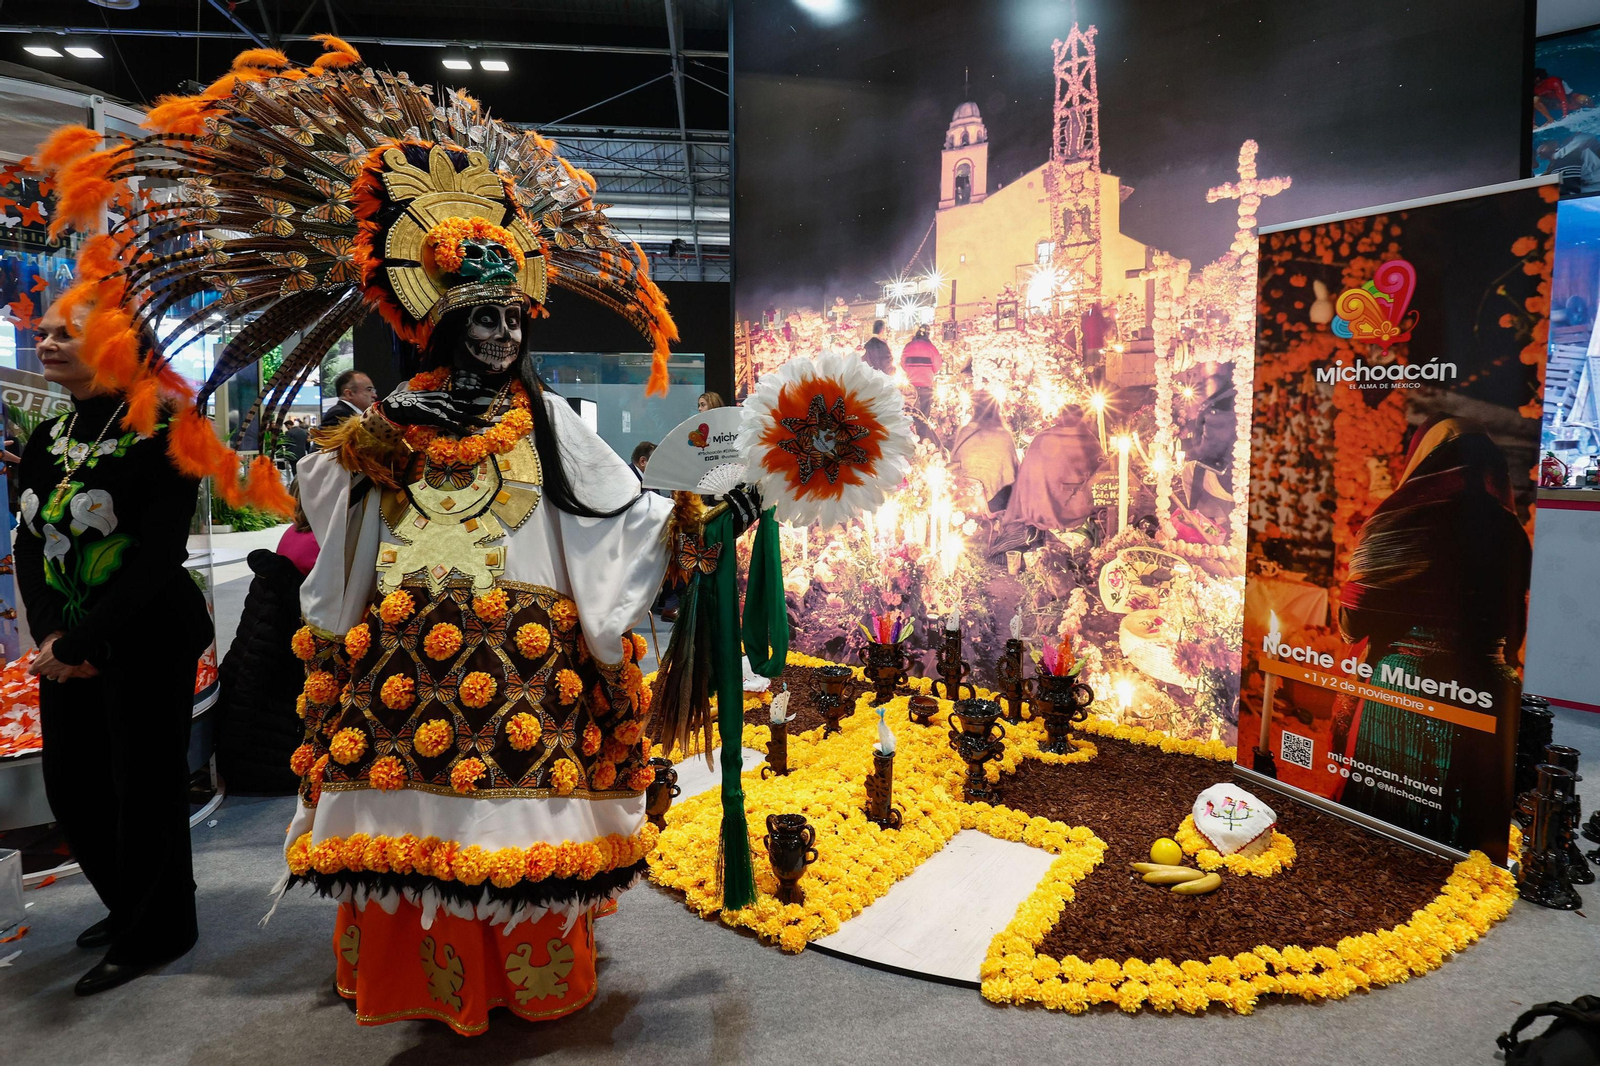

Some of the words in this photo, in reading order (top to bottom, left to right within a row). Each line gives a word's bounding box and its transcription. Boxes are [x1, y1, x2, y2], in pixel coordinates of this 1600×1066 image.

[1316, 357, 1457, 385] Michoacán
[1391, 381, 1421, 389] MÉXICO
[1262, 634, 1334, 669] Noche
[1340, 656, 1374, 678] de
[1380, 663, 1494, 709] Muertos
[1320, 676, 1328, 686] y
[1329, 677, 1338, 687] 2
[1339, 680, 1356, 692] de
[1358, 686, 1425, 711] noviembre
[1327, 751, 1443, 797] michoacan.travel
[1376, 781, 1442, 810] @Michoacan
